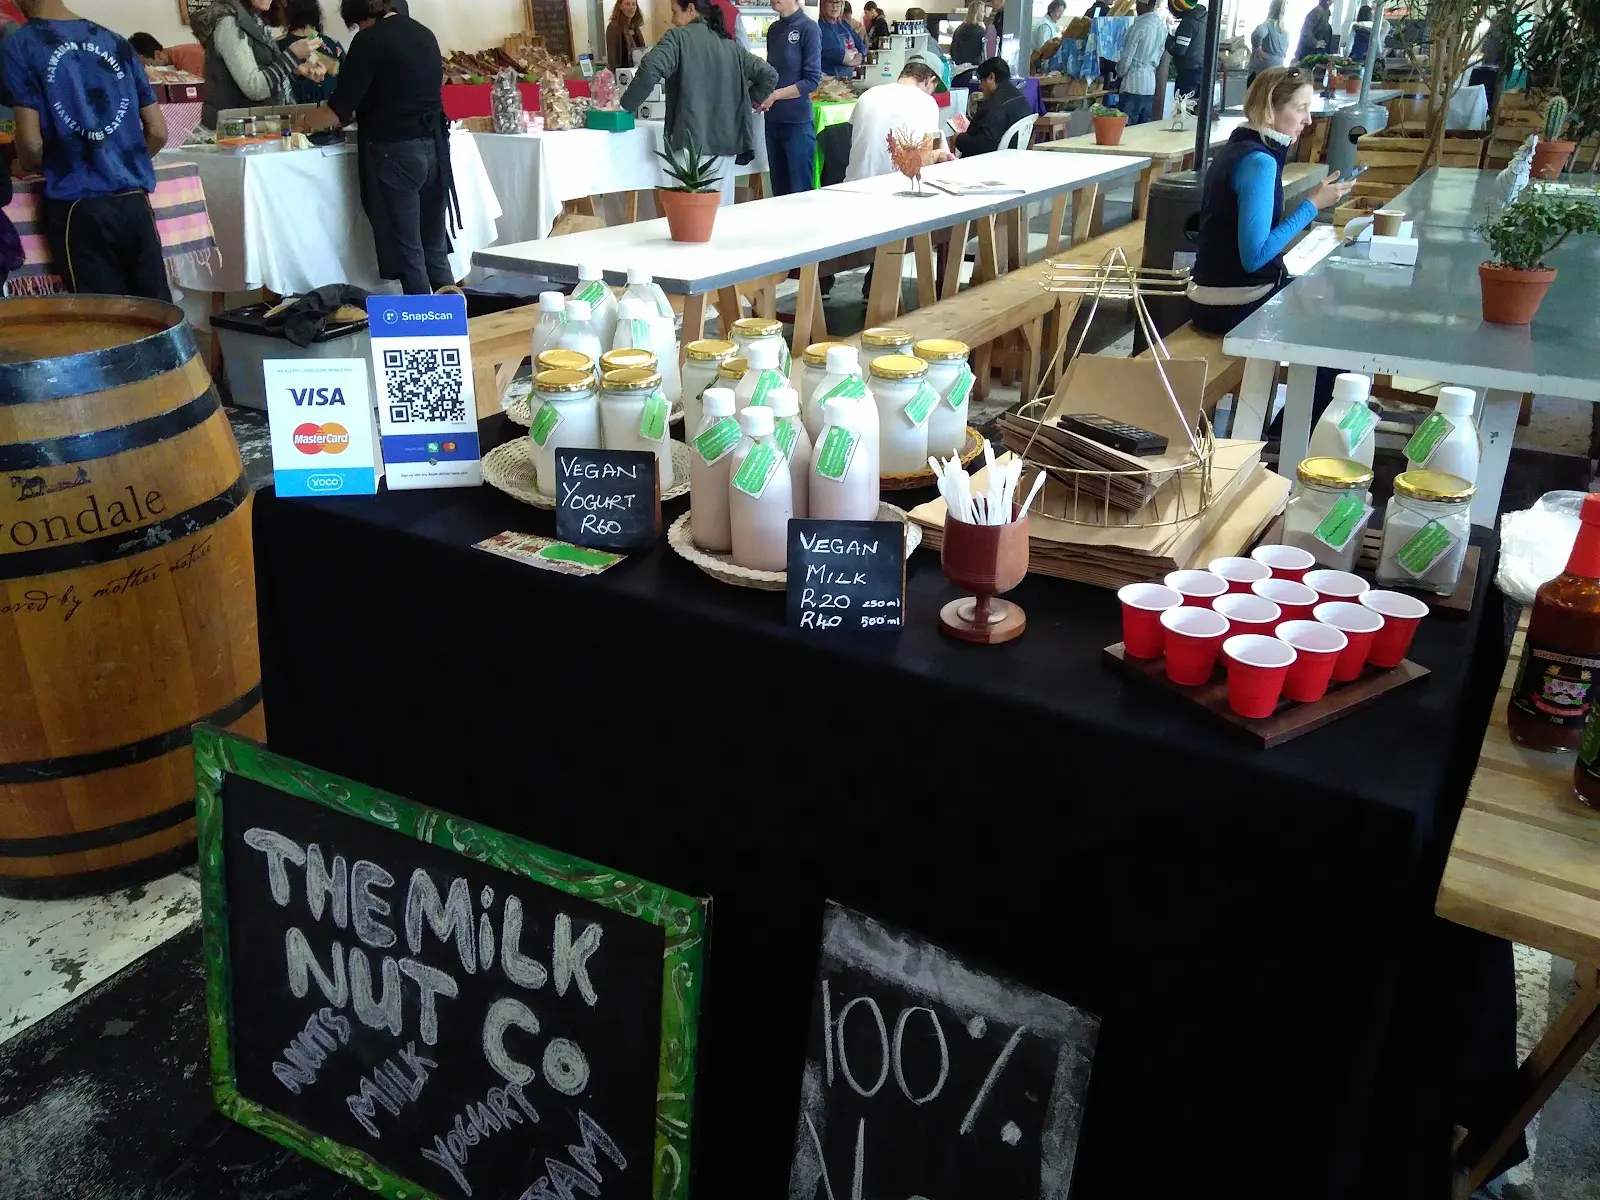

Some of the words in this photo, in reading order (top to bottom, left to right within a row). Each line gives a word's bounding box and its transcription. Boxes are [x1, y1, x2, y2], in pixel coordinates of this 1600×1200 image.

[104, 97, 130, 135] SAFARI
[401, 311, 453, 323] SnapScan
[285, 387, 346, 406] VISA
[294, 433, 348, 445] MasterCard
[560, 456, 637, 479] VEGAN
[561, 481, 636, 511] YOGURT
[0, 485, 165, 547] ondale
[580, 514, 622, 535] R60
[799, 531, 879, 556] VEGAN
[60, 585, 82, 623] by
[92, 563, 162, 599] mother
[168, 534, 213, 574] nature
[805, 564, 868, 585] MILK
[800, 588, 851, 609] R20
[800, 610, 843, 630] R40
[243, 827, 398, 948] THE
[285, 926, 459, 1046] NUT
[345, 1040, 439, 1139] MILK
[420, 1082, 540, 1198] YOGURT
